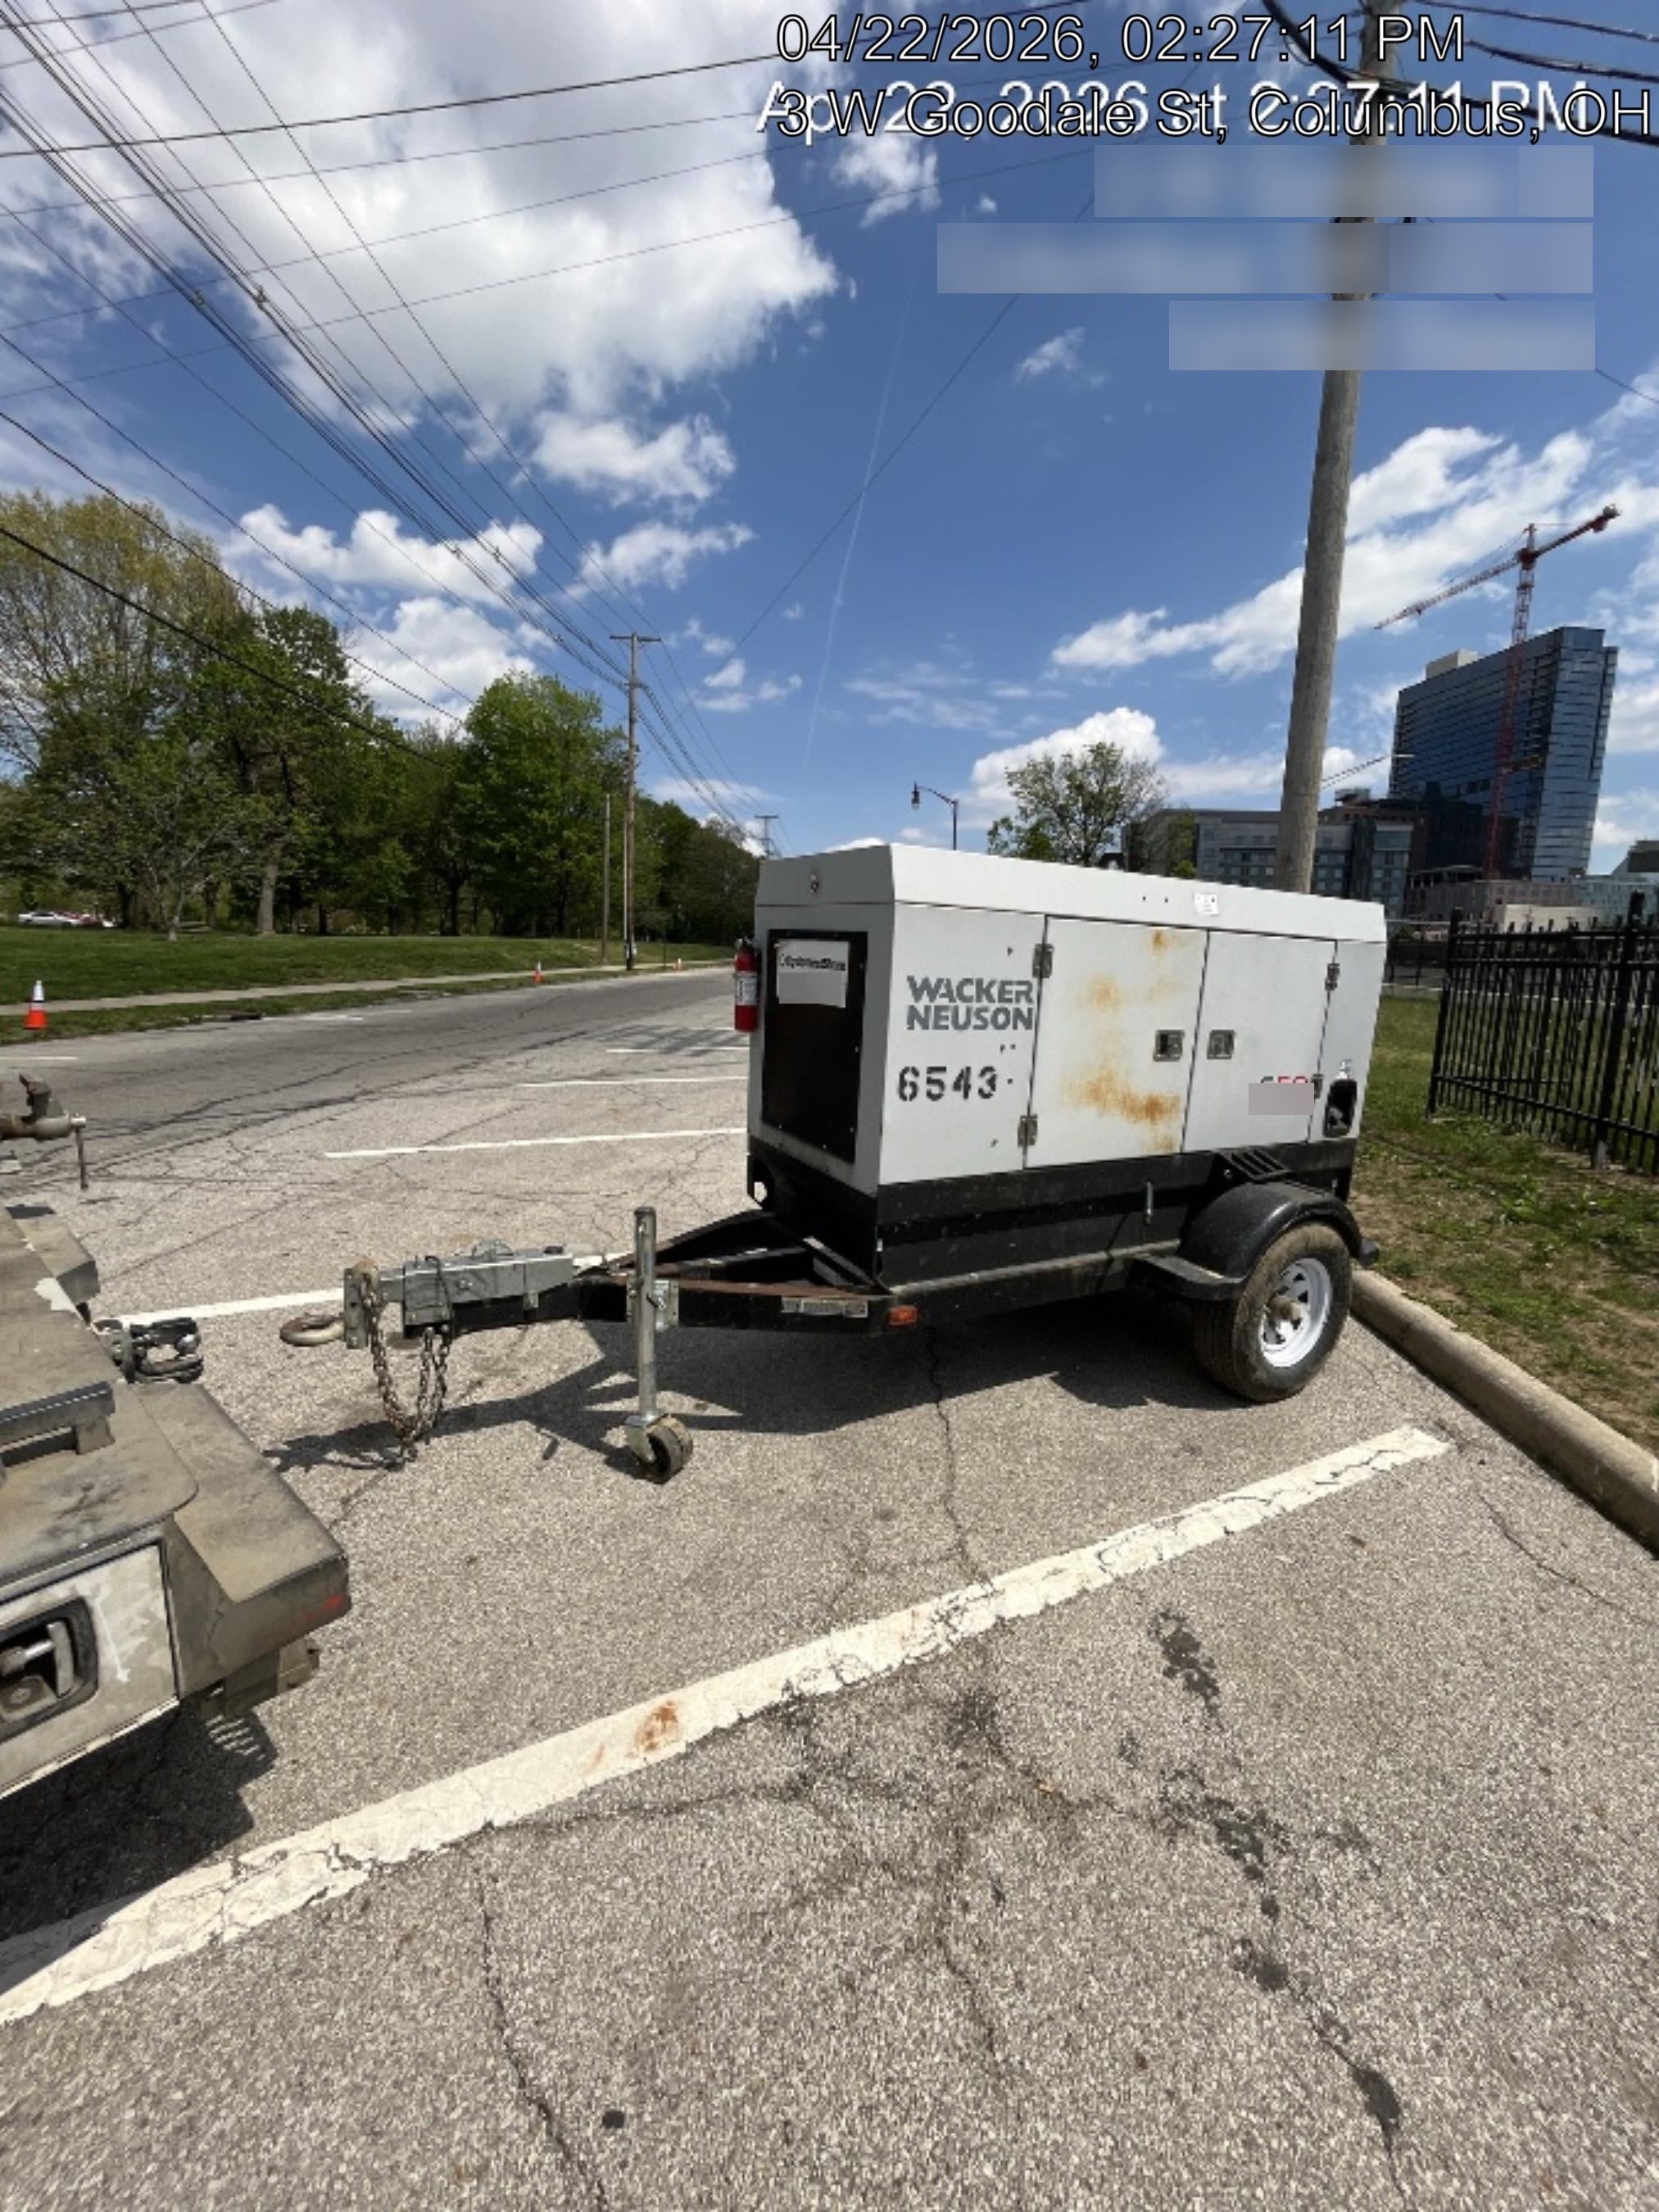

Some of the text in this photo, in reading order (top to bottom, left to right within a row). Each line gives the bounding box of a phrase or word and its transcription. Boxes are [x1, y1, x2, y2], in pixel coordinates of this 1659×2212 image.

[907, 975, 1034, 1004] WACKER
[906, 1004, 1034, 1031] NEUSON
[898, 1066, 997, 1101] 6543
